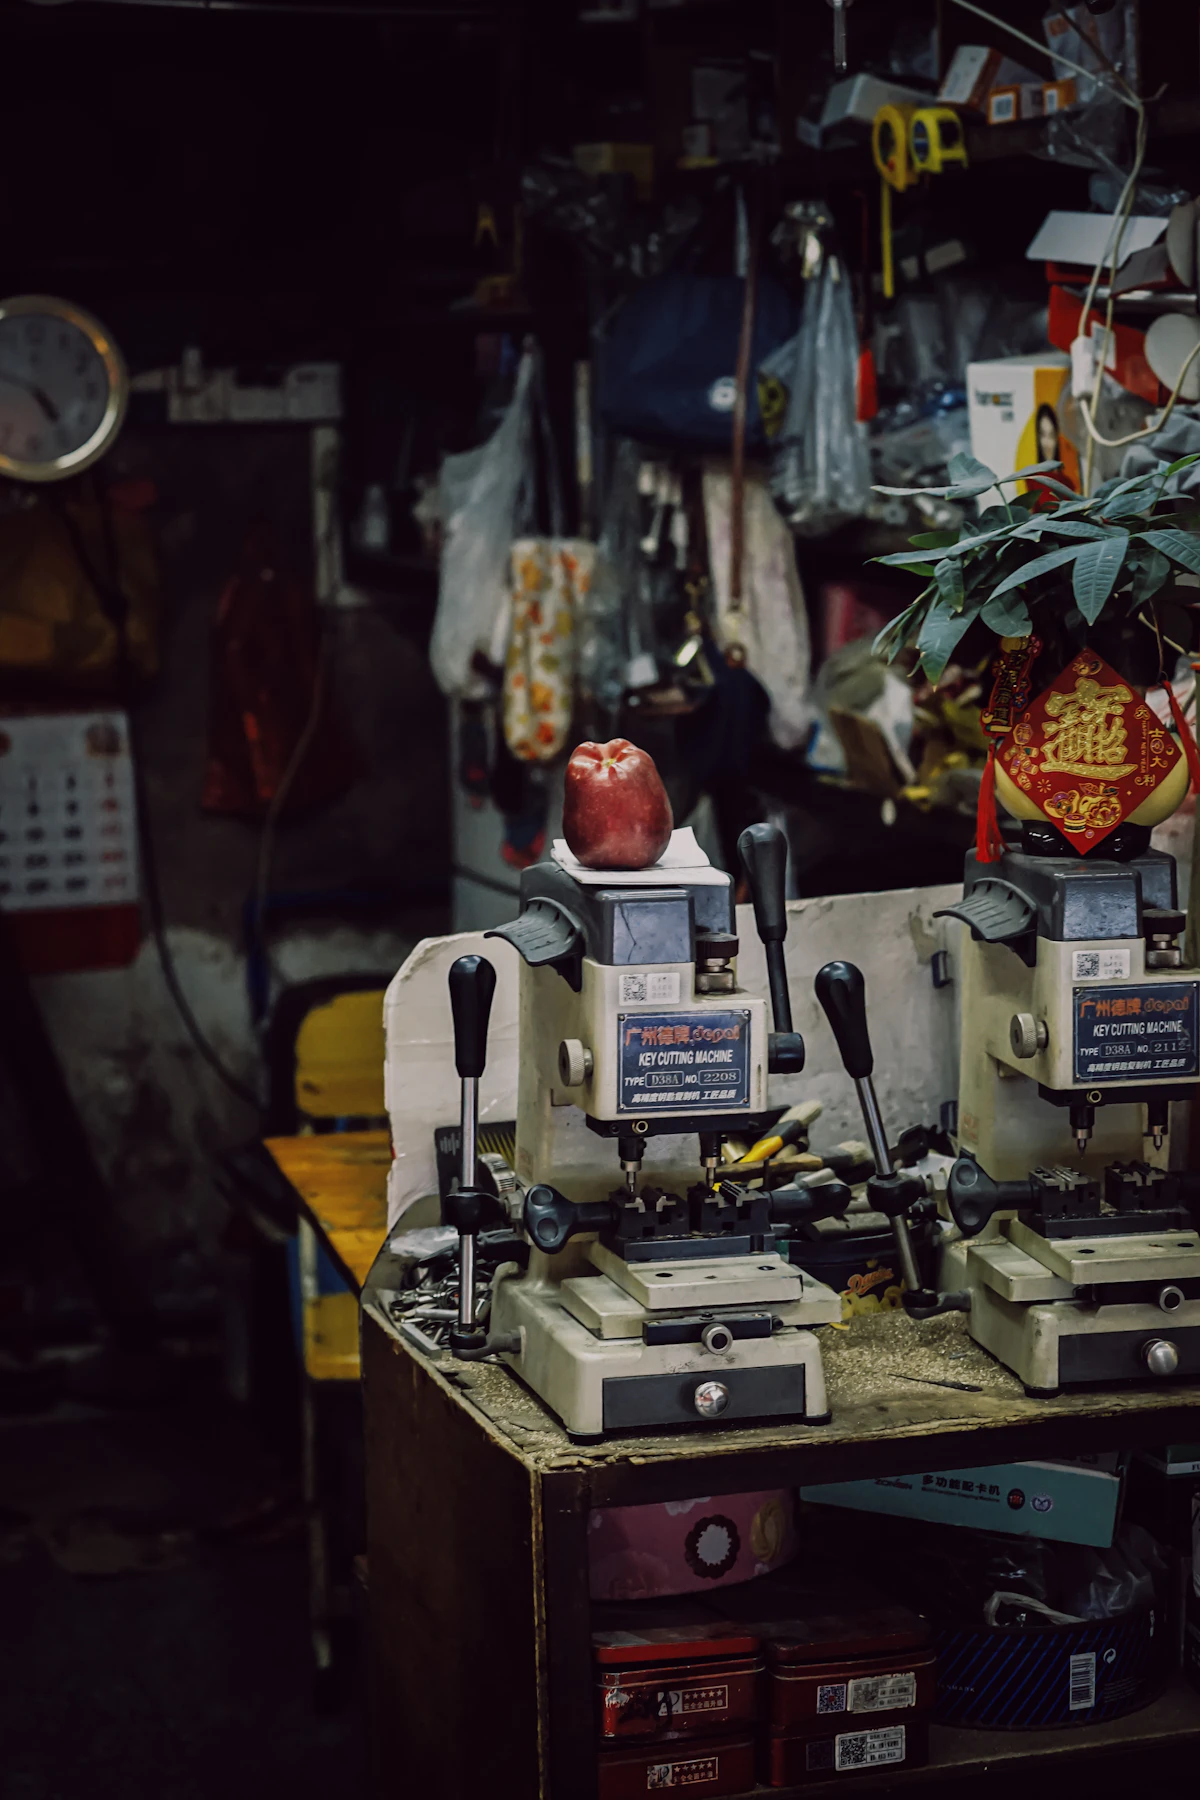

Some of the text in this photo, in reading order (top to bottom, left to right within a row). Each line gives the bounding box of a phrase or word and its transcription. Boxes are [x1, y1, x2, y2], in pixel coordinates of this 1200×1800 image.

[1140, 757, 1148, 774] YEAR
[1080, 997, 1142, 1018] 广州德牌
[625, 1025, 690, 1046] 广州德牌
[1093, 1020, 1183, 1037] KEY CUTTING MACHINE
[638, 1049, 733, 1067] KEY CUTTING MACHINE
[1079, 1047, 1099, 1056] TYPE
[1105, 1045, 1131, 1056] D38A
[1153, 1058, 1187, 1069] 工匠品质
[624, 1076, 644, 1087] TYPE
[652, 1073, 679, 1085] D38A
[703, 1071, 737, 1083] 2208
[701, 1088, 736, 1101] 工匠品质
[922, 1474, 1001, 1496] 多功能配卡机
